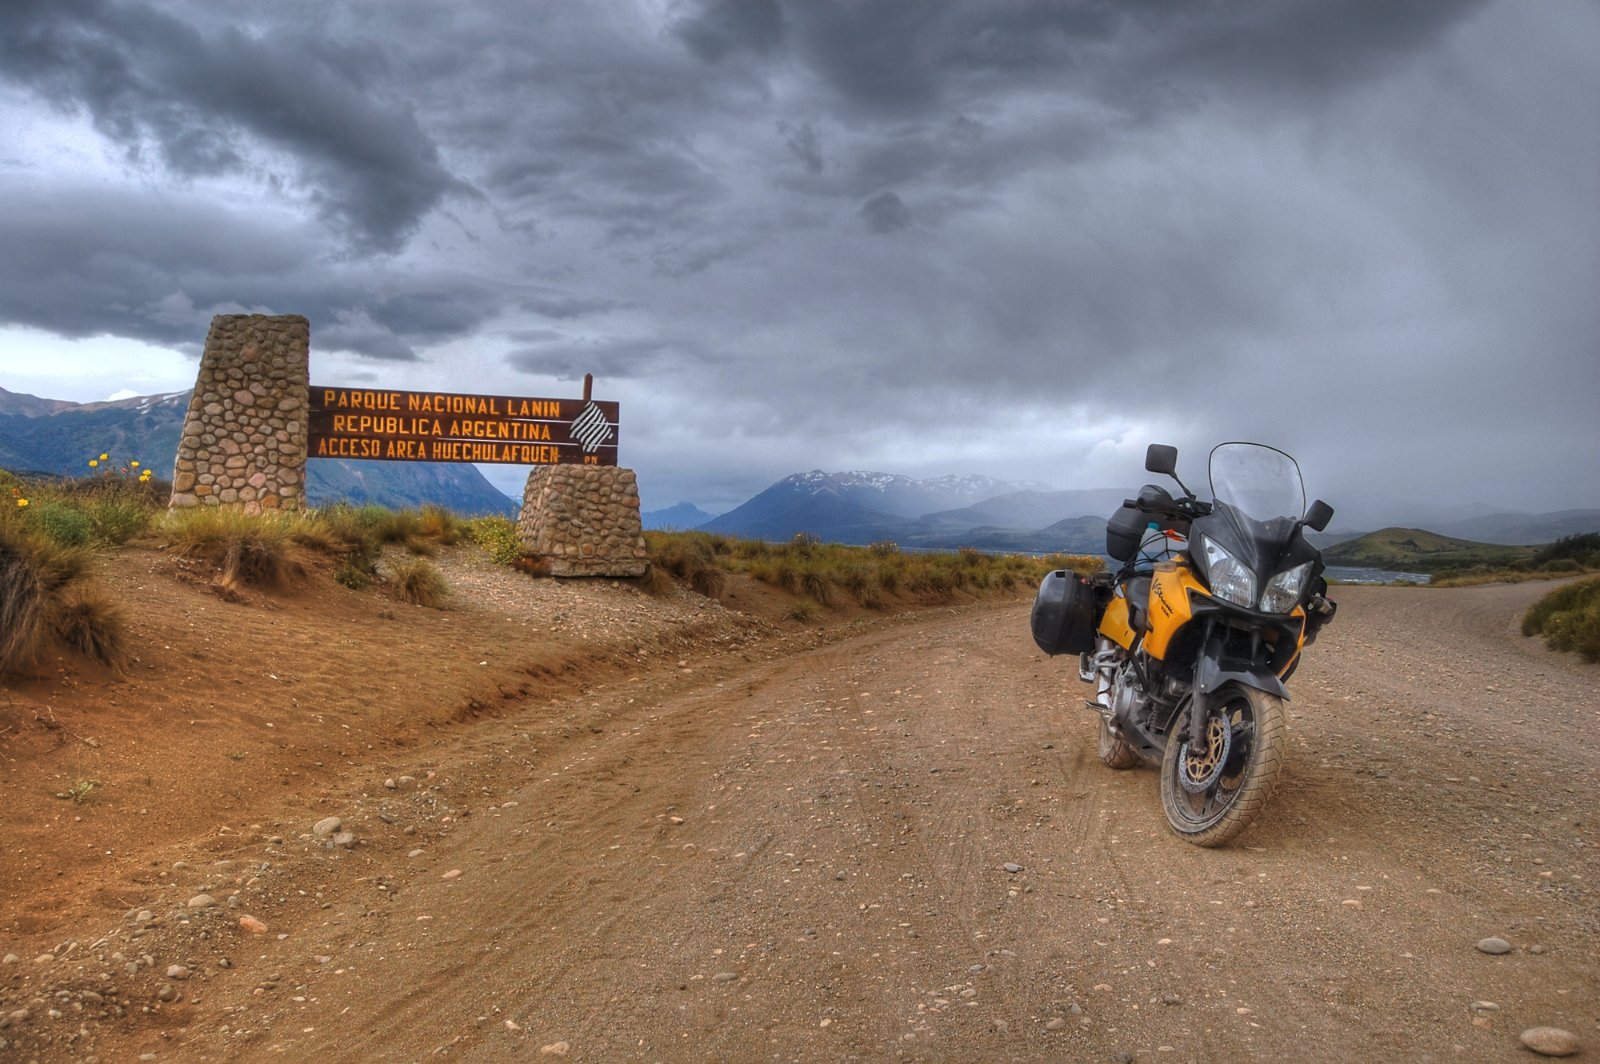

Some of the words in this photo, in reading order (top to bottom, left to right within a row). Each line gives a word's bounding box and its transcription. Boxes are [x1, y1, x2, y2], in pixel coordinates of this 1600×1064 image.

[324, 390, 400, 410] PARQUE
[408, 394, 500, 415] NACIONAL
[507, 400, 561, 417] LANIN
[334, 415, 442, 436] REPUBLICA
[450, 420, 551, 440] ARGENTINA
[318, 438, 380, 457] ACCESO
[387, 440, 427, 458] AREA
[432, 441, 559, 463] HUECHULAFQUEN
